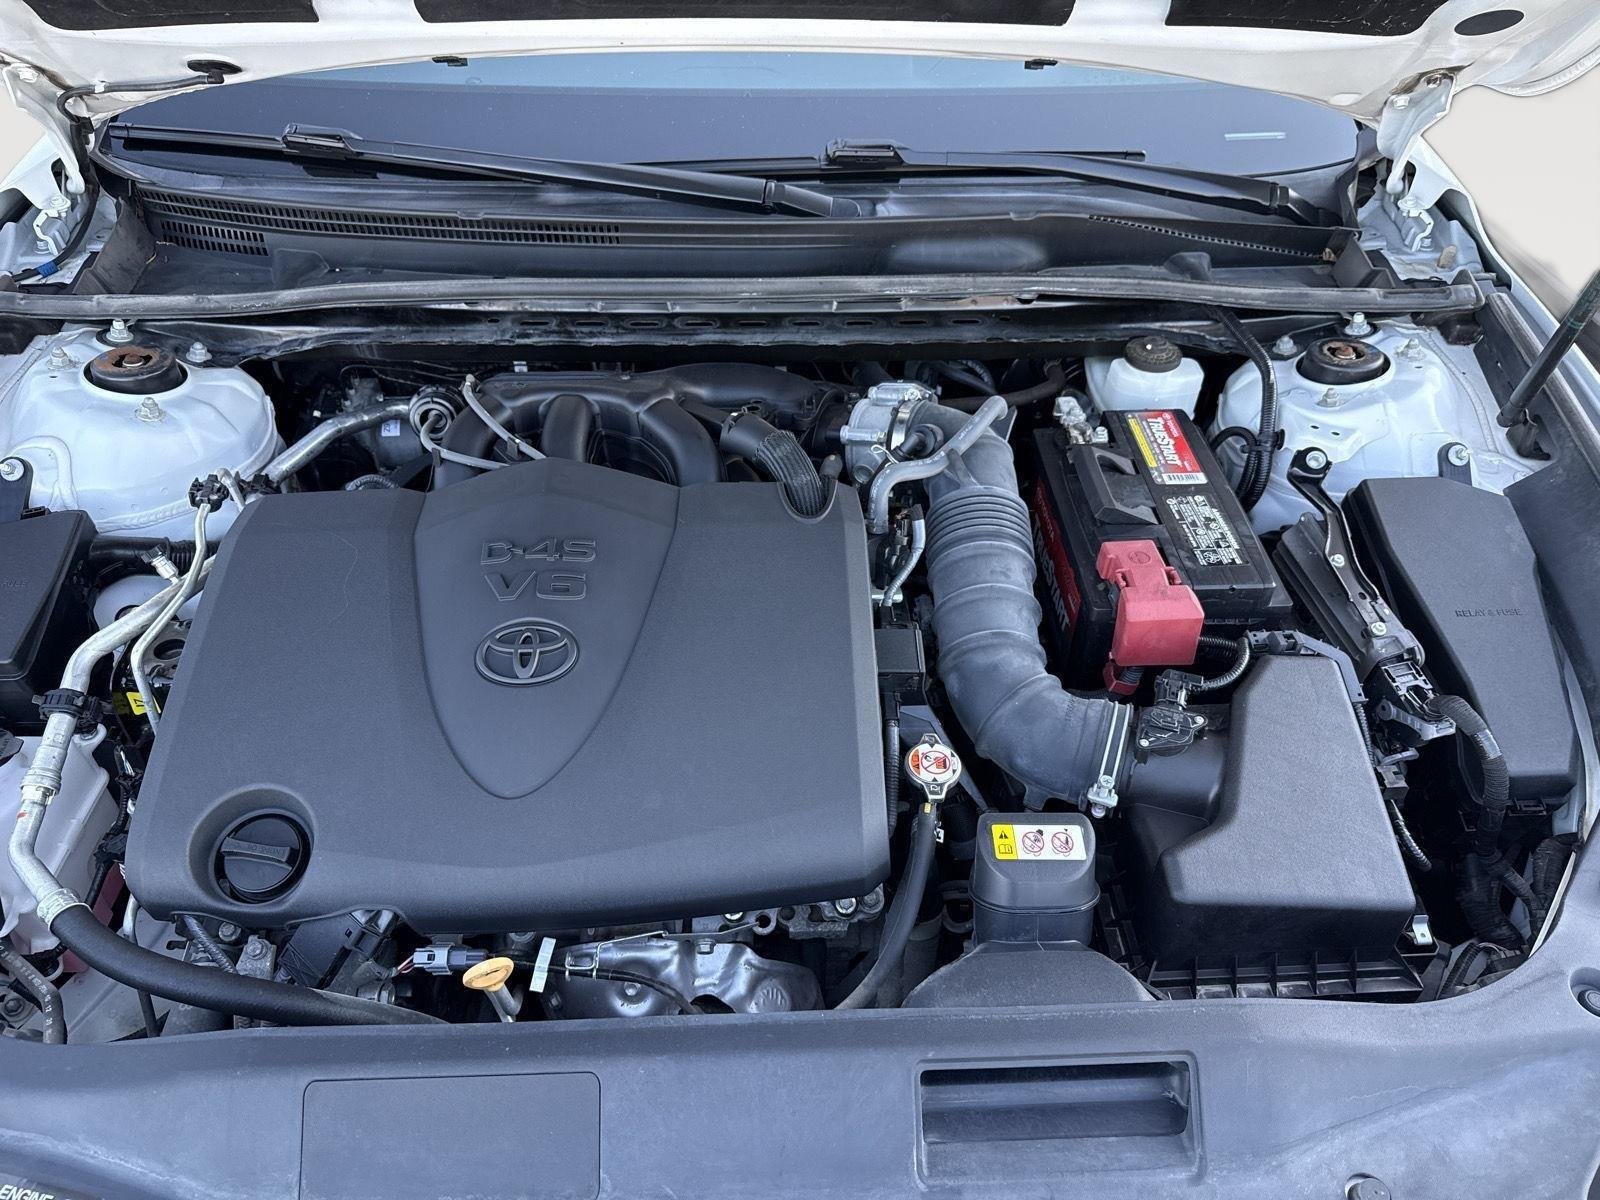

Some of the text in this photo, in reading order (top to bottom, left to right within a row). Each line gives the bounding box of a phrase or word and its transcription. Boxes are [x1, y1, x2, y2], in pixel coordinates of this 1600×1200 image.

[480, 537, 598, 565] D-4S
[484, 570, 588, 601] V6
[1455, 608, 1486, 617] RELAY
[1496, 608, 1522, 616] FUSE
